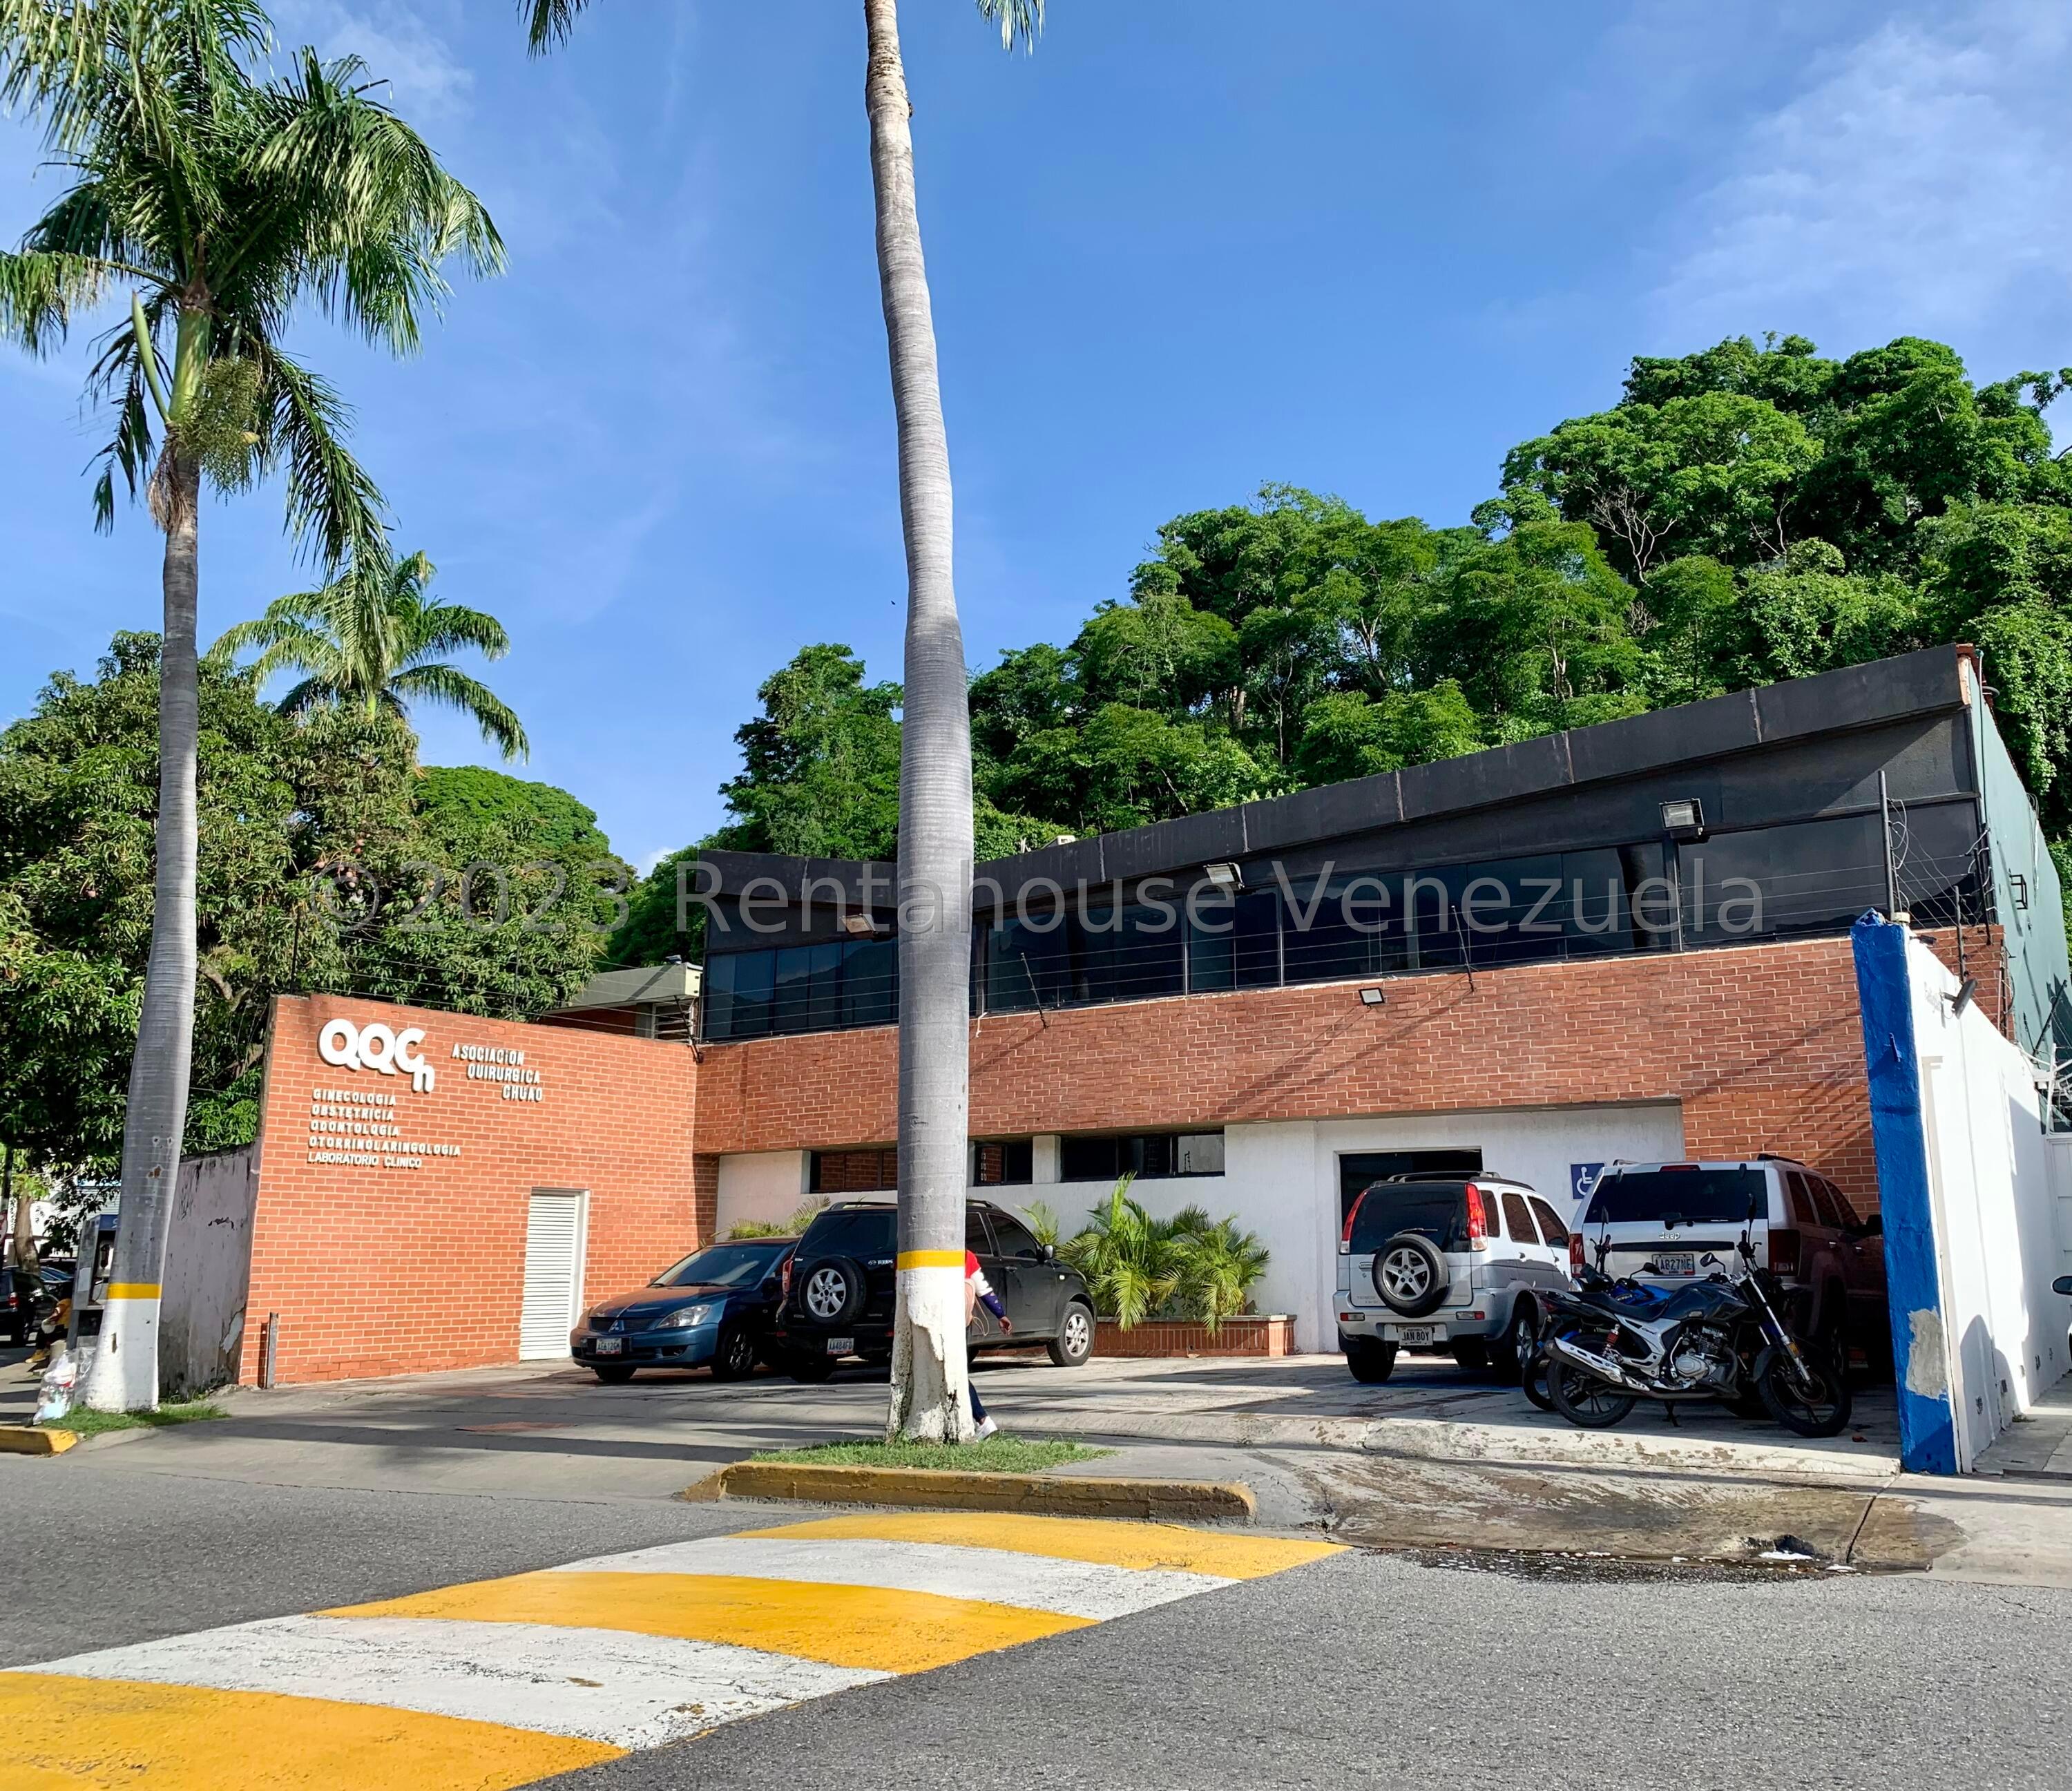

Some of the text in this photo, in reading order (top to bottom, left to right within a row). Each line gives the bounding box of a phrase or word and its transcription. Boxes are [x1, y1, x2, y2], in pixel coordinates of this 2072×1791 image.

[451, 1043, 525, 1066] ASOCIACION
[467, 1063, 540, 1084] QUIRURGICA
[312, 1088, 396, 1107] GINECOLOGIA
[502, 1084, 543, 1102] CHUAO
[311, 1104, 394, 1122] OBSTETRICIA
[309, 1120, 400, 1138] ODONTOLOGIA
[308, 1136, 461, 1157] OTORRINOLARINGOLOGIA
[307, 1151, 422, 1169] LABORATORIO CLINICO
